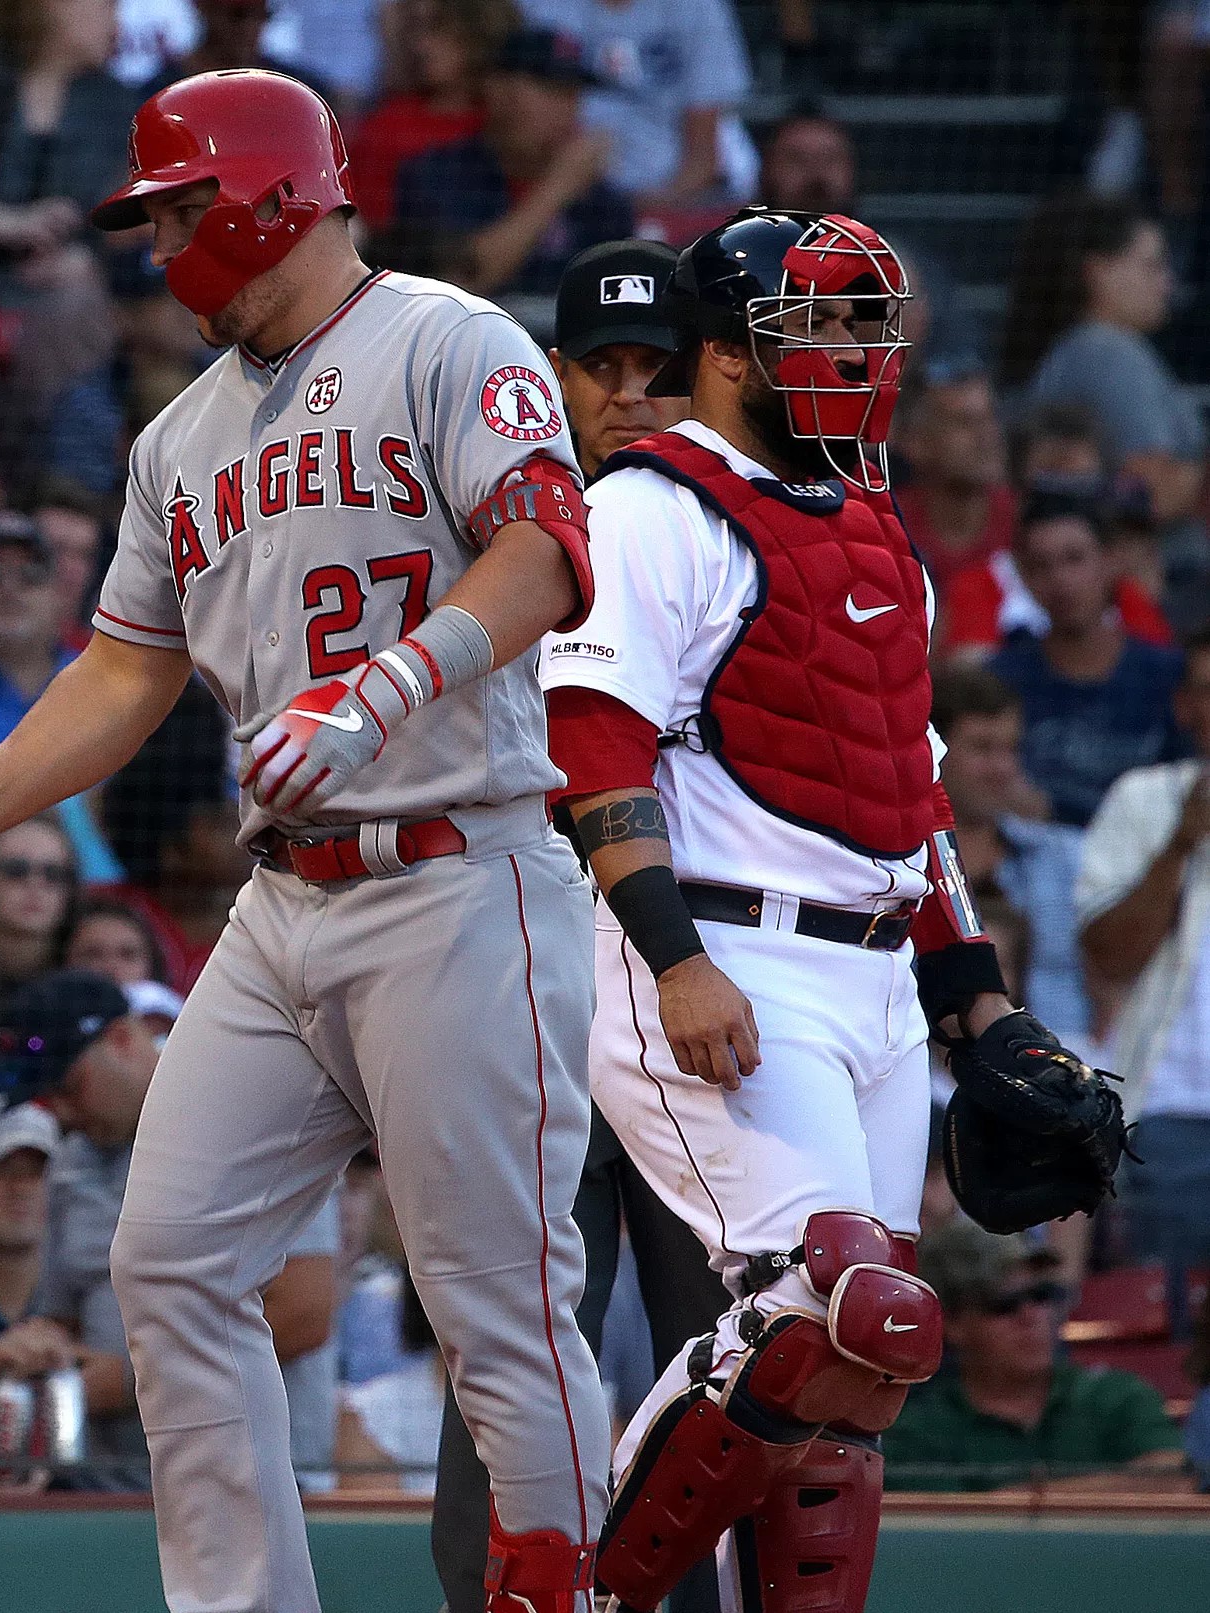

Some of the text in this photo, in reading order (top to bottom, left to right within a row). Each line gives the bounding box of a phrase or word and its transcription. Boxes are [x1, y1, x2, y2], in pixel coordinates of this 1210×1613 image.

[509, 381, 544, 425] A
[162, 426, 430, 611] ANGELS
[302, 548, 434, 680] 27
[550, 642, 615, 658] MLB 150
